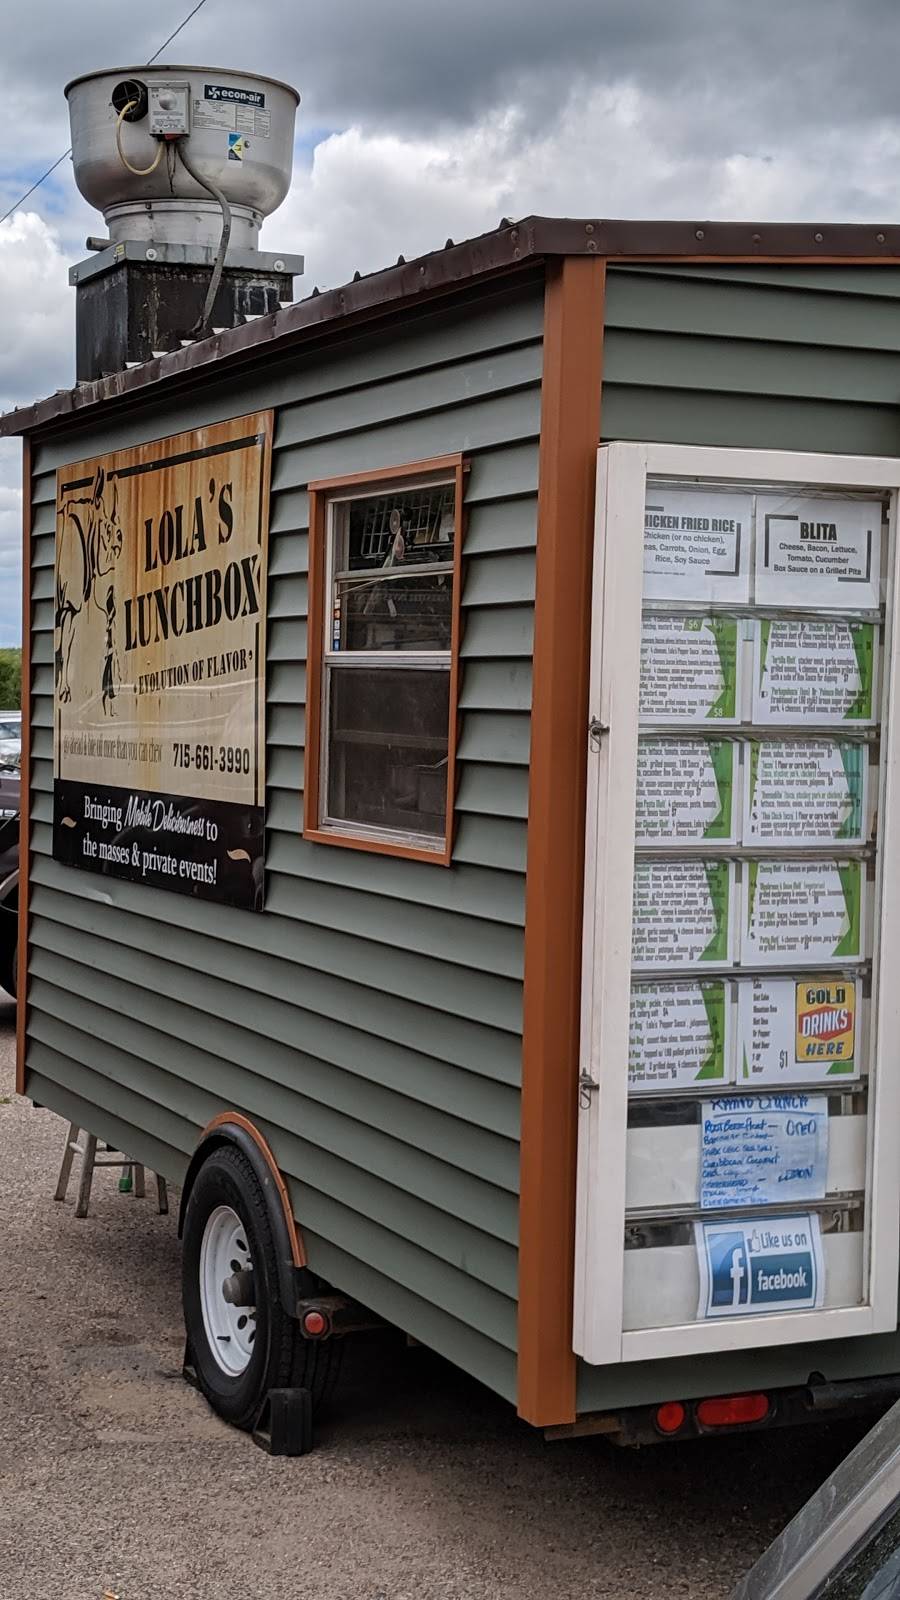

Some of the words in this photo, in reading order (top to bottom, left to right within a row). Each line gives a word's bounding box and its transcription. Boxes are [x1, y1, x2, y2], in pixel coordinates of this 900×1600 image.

[221, 90, 261, 102] econ-air
[145, 478, 233, 572] LOLA'S
[645, 514, 679, 529] HICKEN
[681, 517, 709, 531] FRIED
[712, 519, 735, 532] RICE
[800, 522, 837, 540] BLITA
[779, 543, 805, 551] Cheese,
[808, 544, 829, 553] Bacon,
[655, 555, 672, 563] Rice,
[674, 556, 686, 564] Soy
[787, 554, 813, 562] Tomato,
[124, 554, 259, 650] LUNCHBOX
[139, 663, 190, 695] EVOLUTION
[192, 660, 204, 682] OF
[207, 649, 247, 678] FLAVOR
[173, 743, 250, 774] 715-661-3990
[84, 795, 122, 833] Bringing
[124, 794, 152, 829] Mobile
[153, 800, 204, 836] Deliciousness
[207, 821, 218, 841] to
[83, 833, 96, 856] the
[100, 846, 129, 865] masses
[131, 842, 140, 866] &
[143, 848, 176, 876] private
[179, 859, 217, 884] events!
[806, 987, 845, 1004] COLD
[803, 1009, 847, 1037] DRINKS
[806, 1042, 844, 1055] HERE
[780, 1050, 788, 1070] $1
[761, 1232, 780, 1248] Like
[782, 1234, 792, 1247] us
[795, 1233, 807, 1246] on
[758, 1266, 807, 1291] facebook
